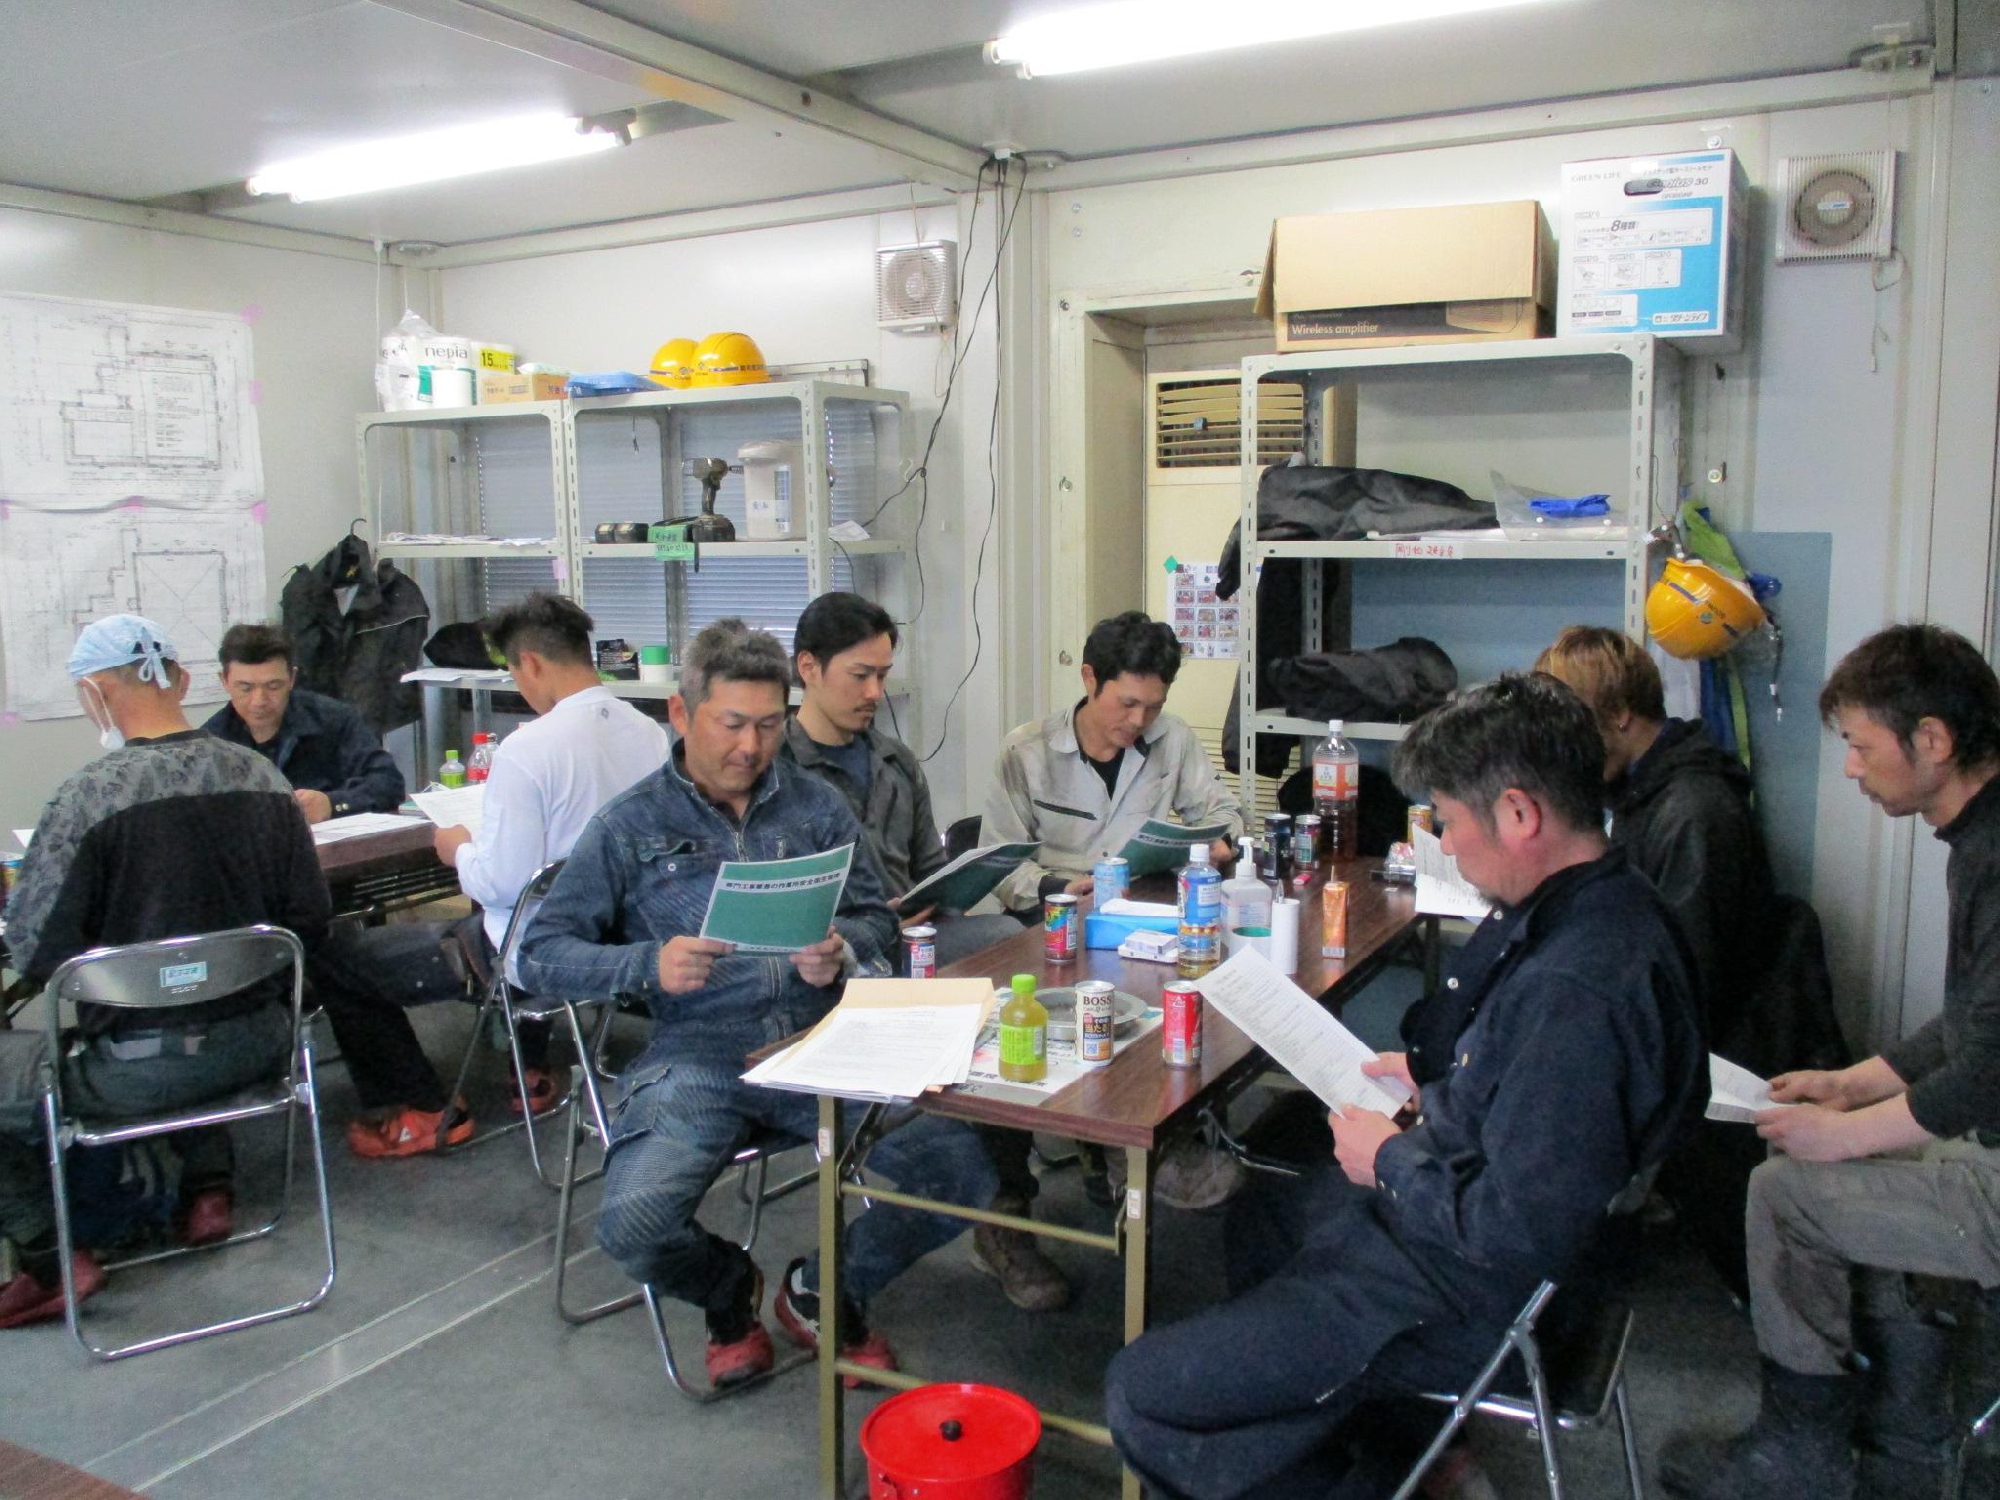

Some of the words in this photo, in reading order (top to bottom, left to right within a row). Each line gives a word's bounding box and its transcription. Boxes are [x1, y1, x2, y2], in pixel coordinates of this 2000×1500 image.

[1694, 177, 1709, 186] 30
[1292, 323, 1333, 335] Wireless
[1335, 322, 1378, 335] amplifier
[424, 344, 468, 360] nepia
[481, 351, 494, 367] 15
[1083, 995, 1111, 1005] BOSS
